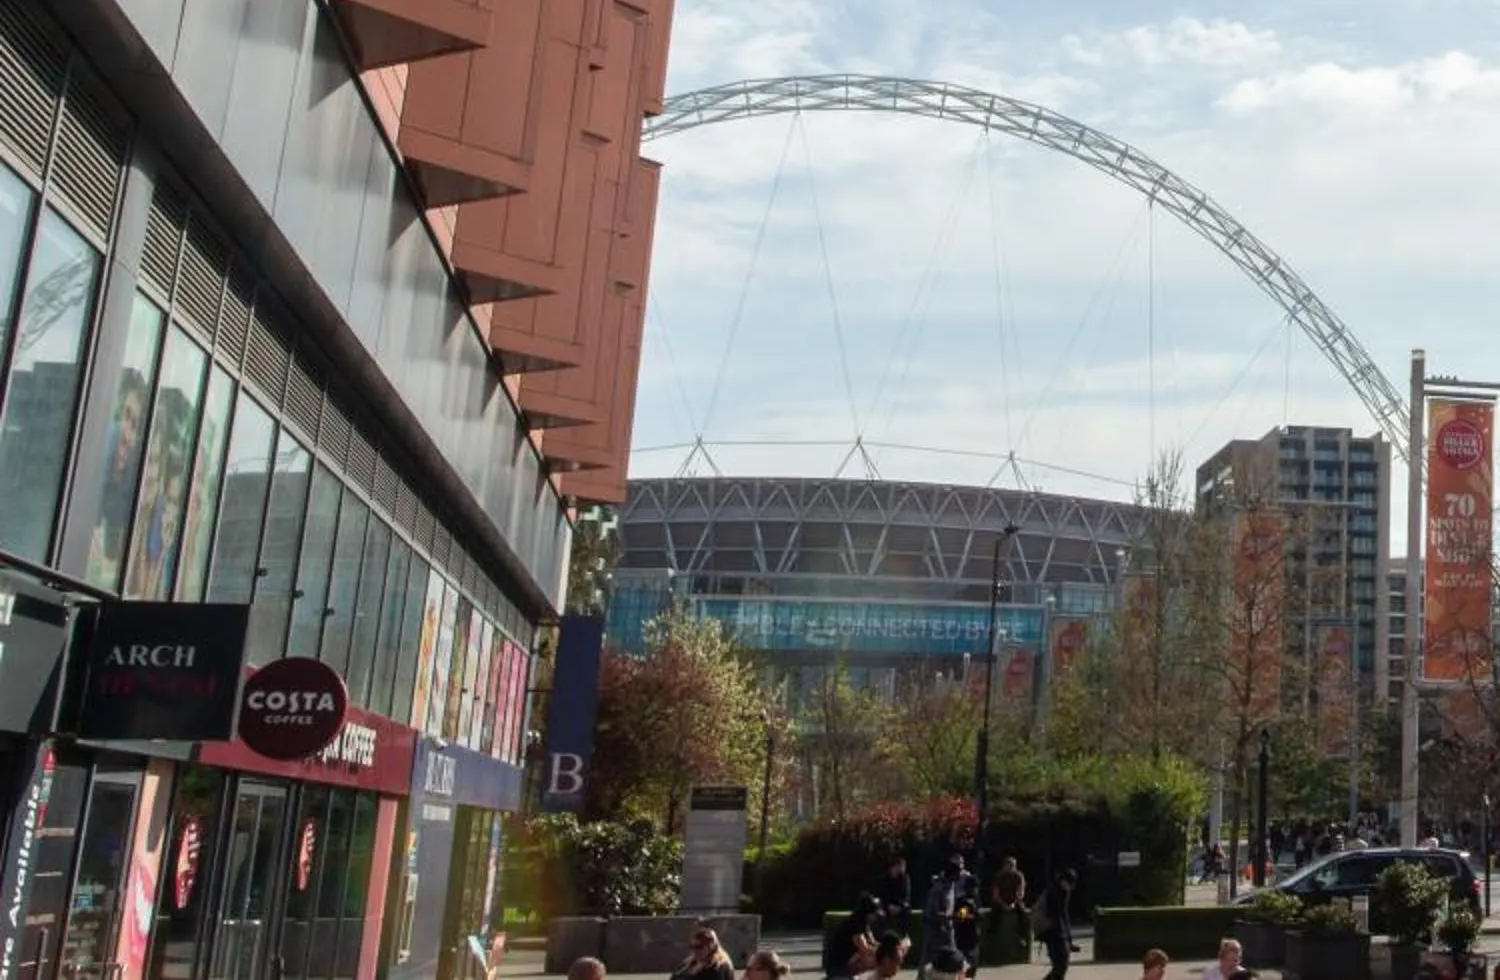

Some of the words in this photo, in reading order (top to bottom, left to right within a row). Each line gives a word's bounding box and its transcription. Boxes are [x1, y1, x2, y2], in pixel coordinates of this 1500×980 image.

[1444, 493, 1475, 517] 70
[104, 644, 197, 668] ARCH
[247, 690, 336, 713] COSTA
[263, 714, 313, 725] COFFEE
[548, 752, 584, 794] B
[9, 783, 40, 929] Available
